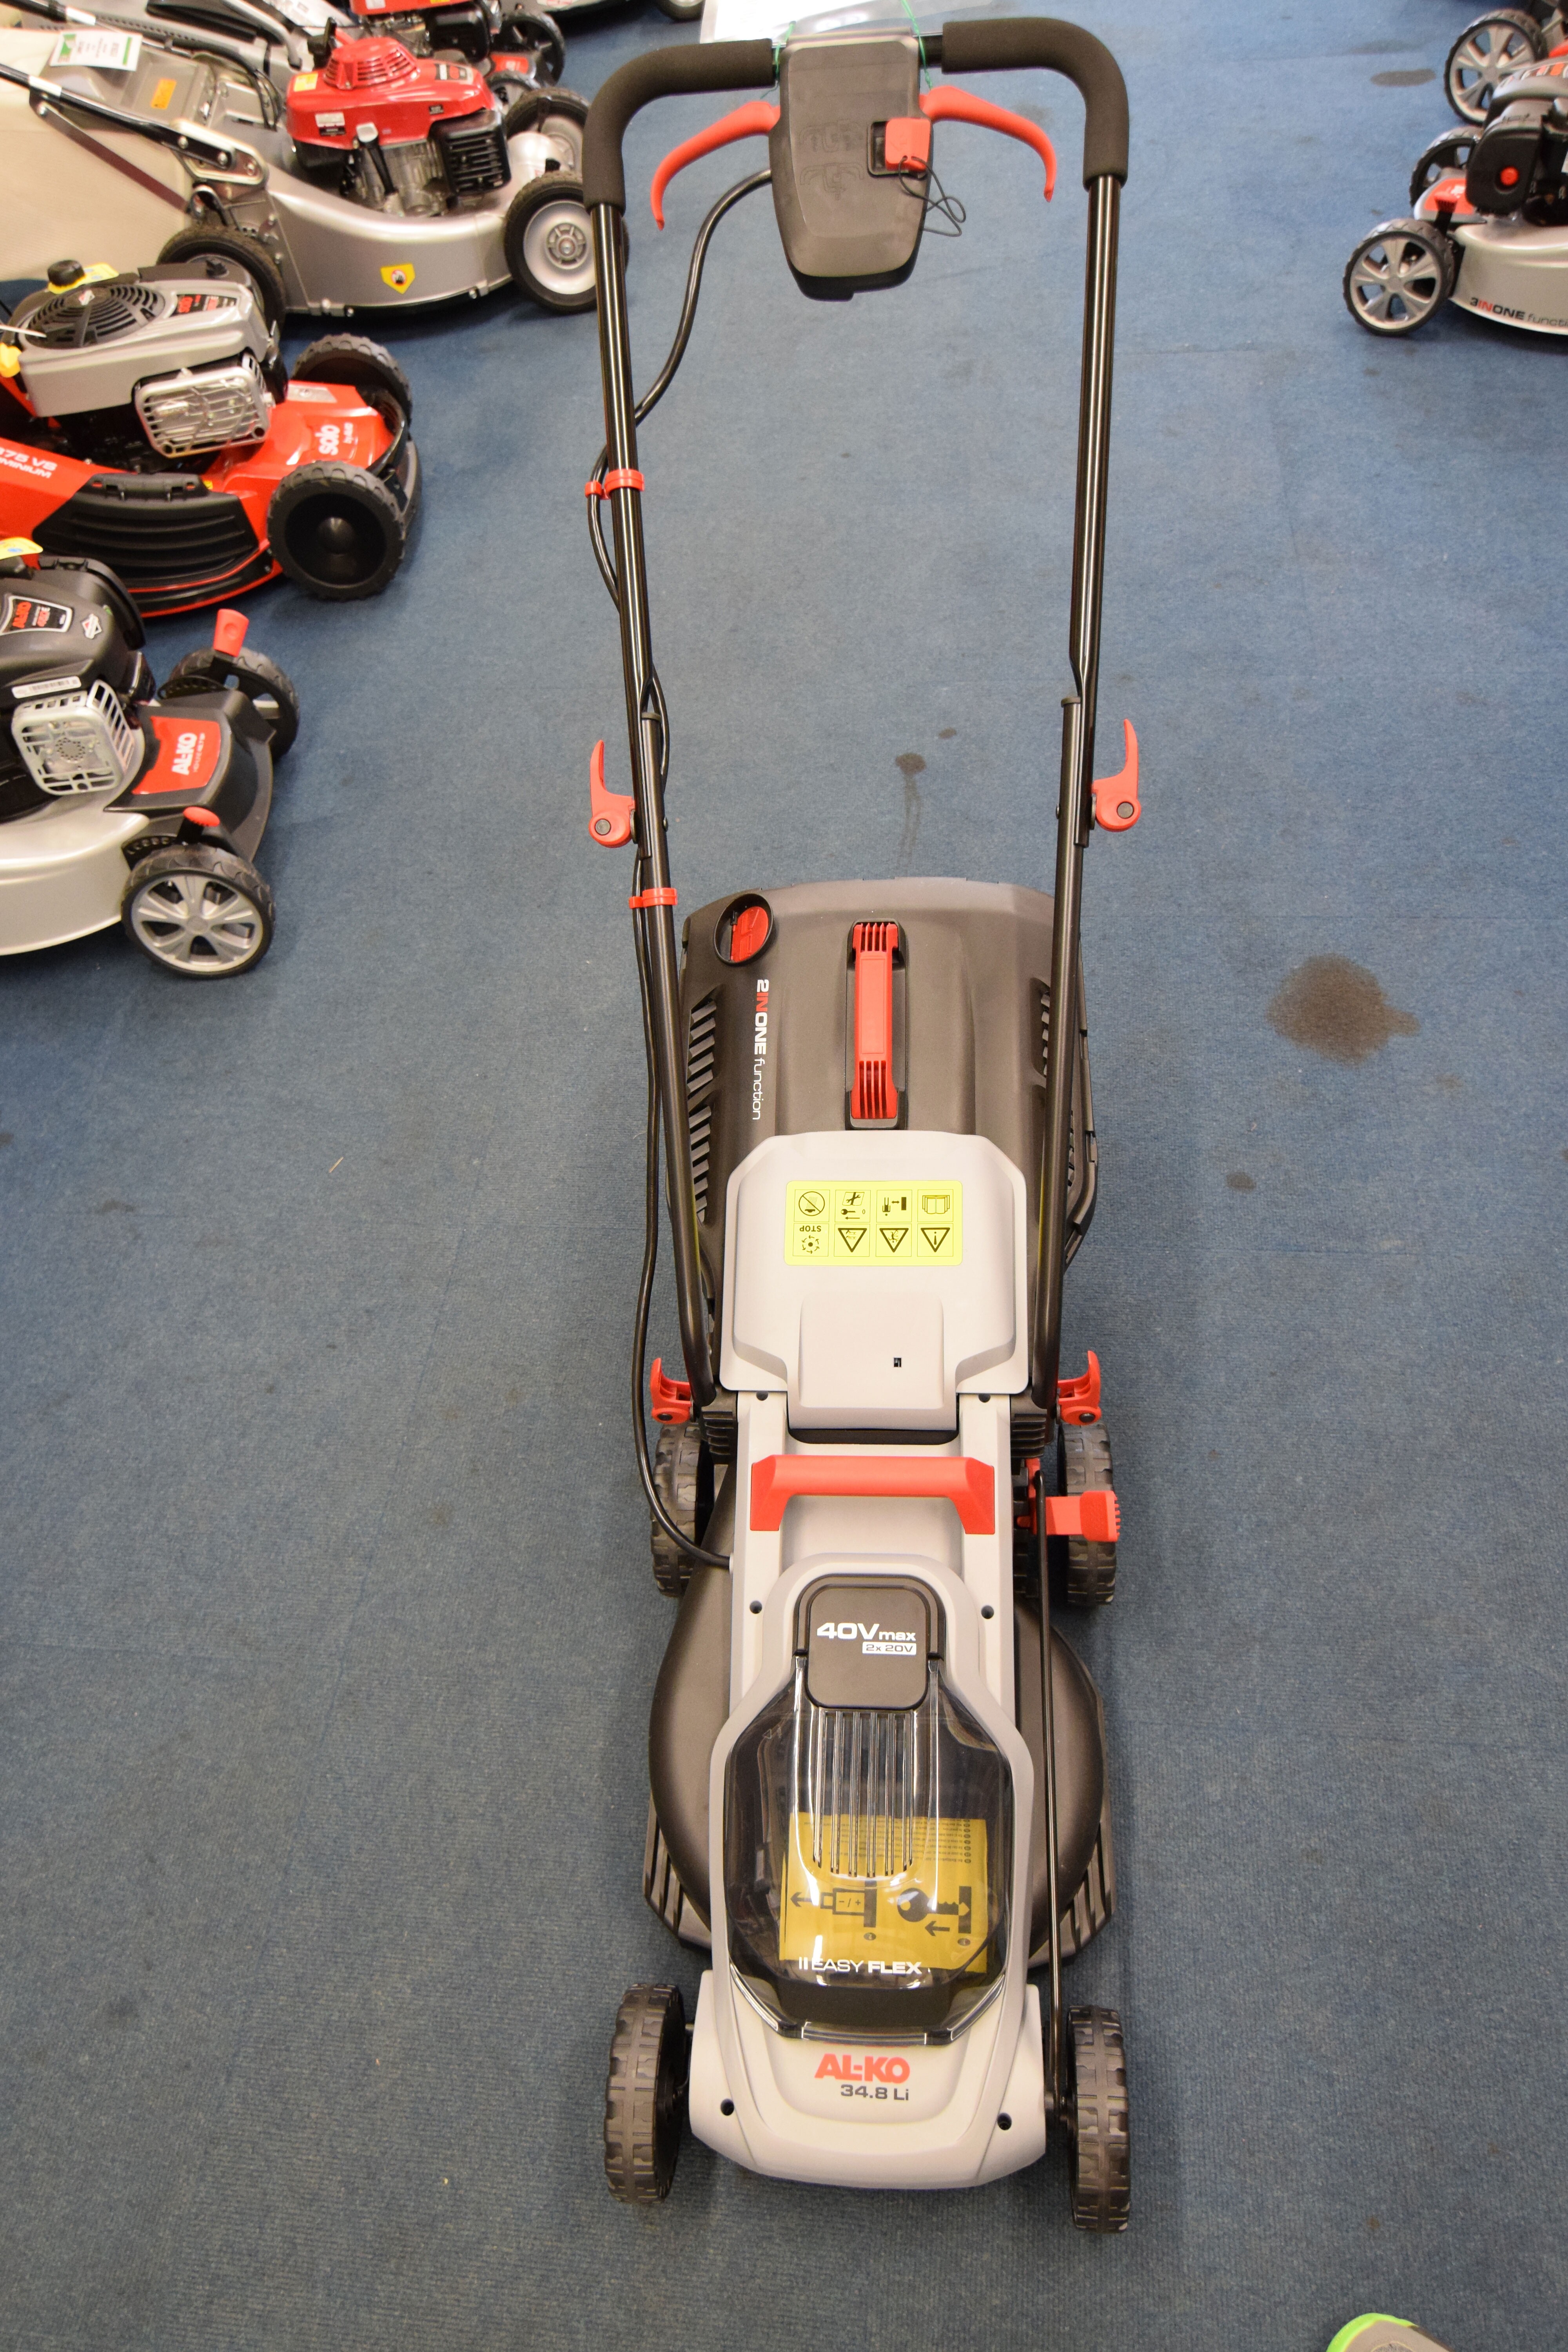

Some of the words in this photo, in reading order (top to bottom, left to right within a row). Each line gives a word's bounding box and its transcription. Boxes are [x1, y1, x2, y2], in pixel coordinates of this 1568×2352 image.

[1470, 297, 1526, 320] 3INONE
[315, 425, 340, 456] solo
[172, 732, 197, 775] AL-KO
[754, 979, 769, 1055] 2INONE
[752, 1058, 765, 1120] function
[811, 1958, 864, 1973] EASY
[868, 1960, 922, 1974] FLEX
[814, 2053, 910, 2084] AL-KO
[840, 2084, 888, 2100] 34.8
[893, 2088, 909, 2101] Li
